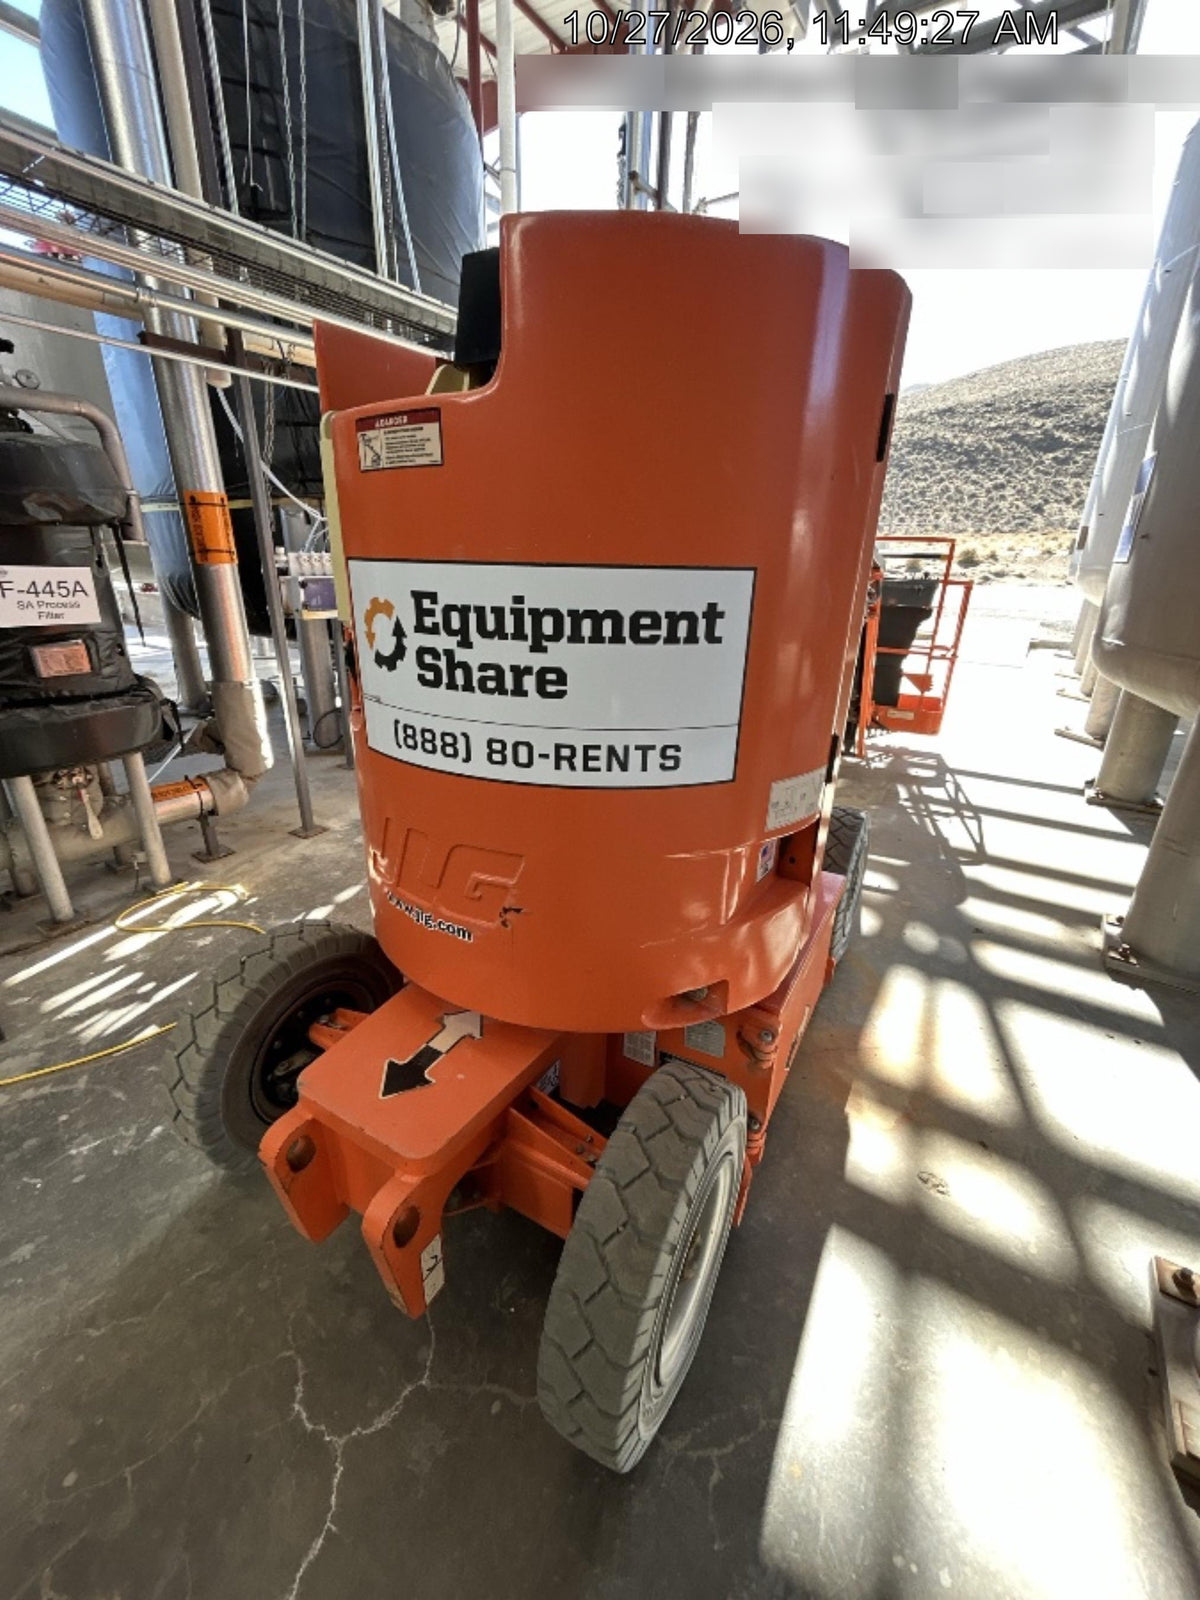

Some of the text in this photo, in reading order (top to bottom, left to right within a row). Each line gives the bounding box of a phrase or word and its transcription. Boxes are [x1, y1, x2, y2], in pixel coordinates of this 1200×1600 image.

[410, 589, 726, 653] Equipment
[415, 645, 568, 699] Share
[393, 718, 682, 772] (888) 80-RENTS
